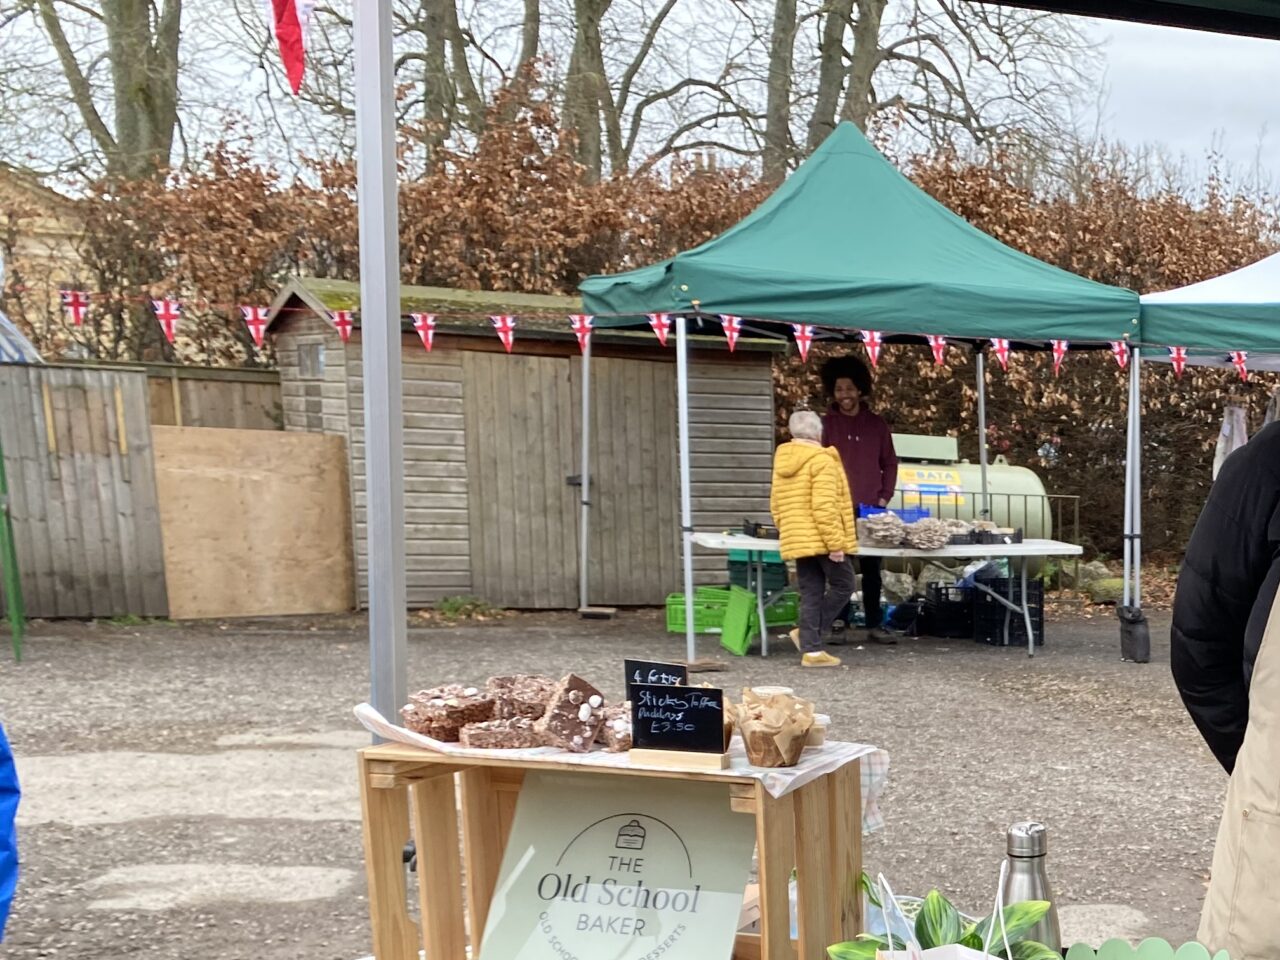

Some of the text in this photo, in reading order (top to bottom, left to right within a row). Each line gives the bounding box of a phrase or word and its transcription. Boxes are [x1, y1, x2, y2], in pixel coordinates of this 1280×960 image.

[608, 855, 645, 874] THE
[537, 872, 701, 914] Old School
[539, 911, 552, 934] OLD
[576, 913, 646, 936] BAKER
